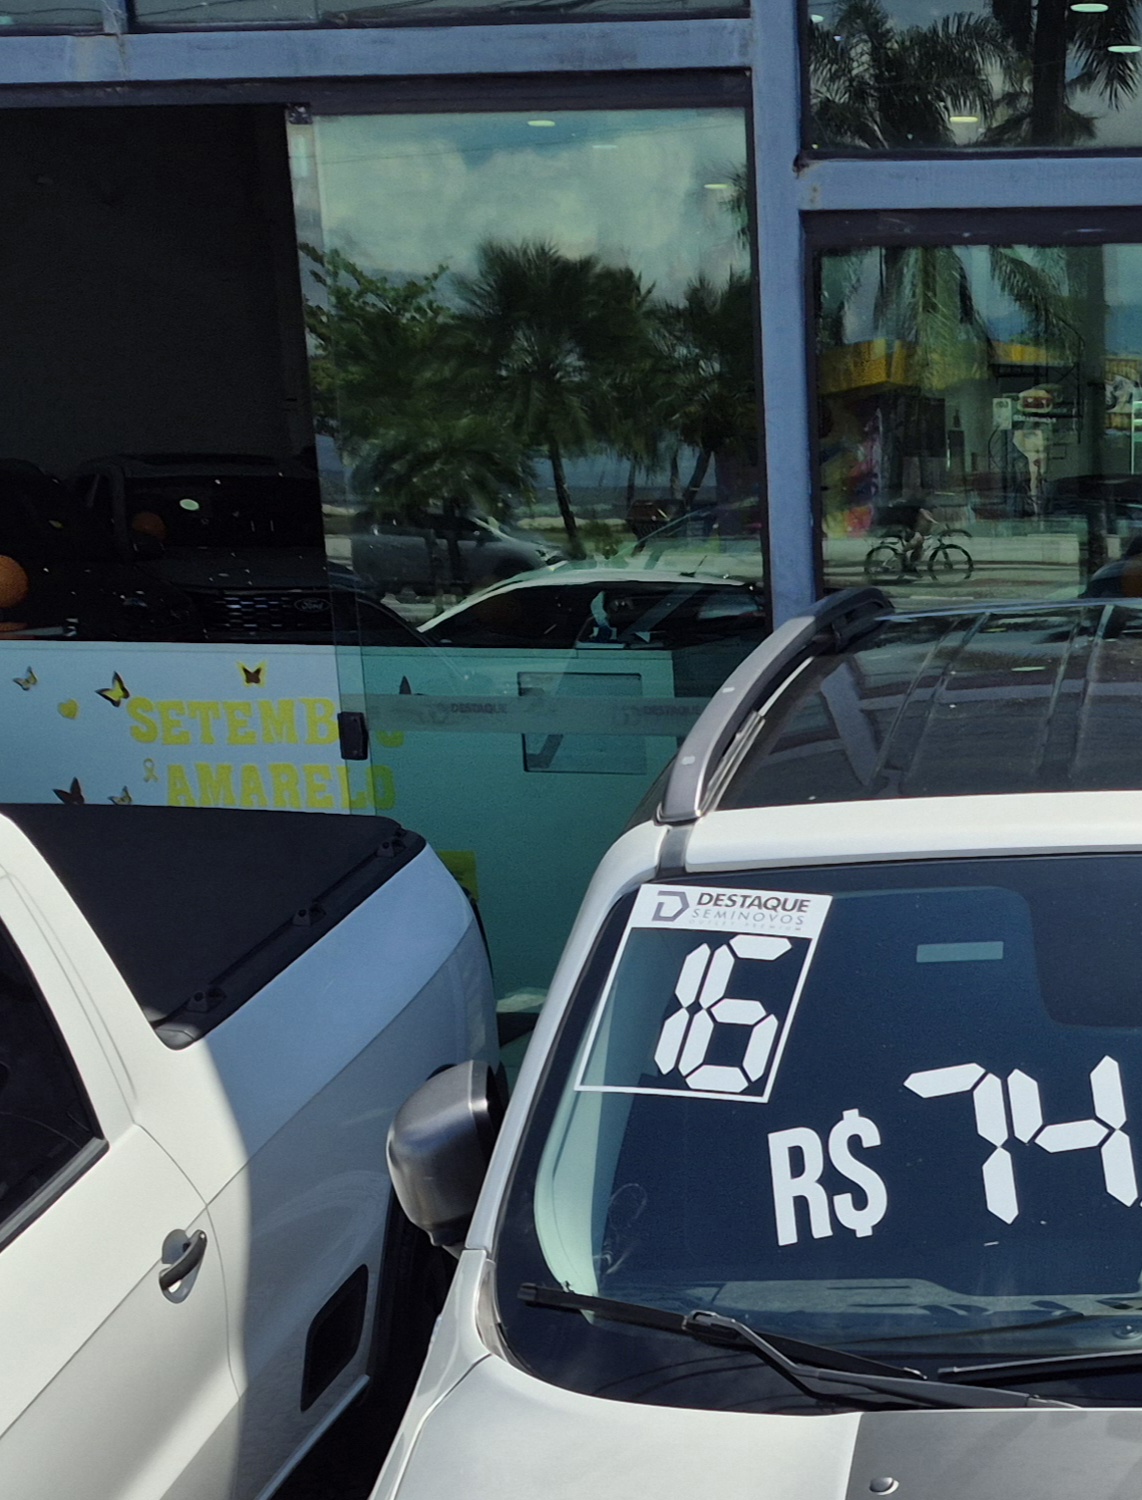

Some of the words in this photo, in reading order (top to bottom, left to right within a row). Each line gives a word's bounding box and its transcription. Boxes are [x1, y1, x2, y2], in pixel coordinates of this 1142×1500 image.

[127, 696, 404, 748] SETEMB
[166, 762, 396, 810] AMARELO
[691, 908, 805, 926] SEMINOVOS
[696, 892, 811, 914] DESTAQUE
[654, 934, 792, 1093] 16
[768, 1109, 888, 1246] R$
